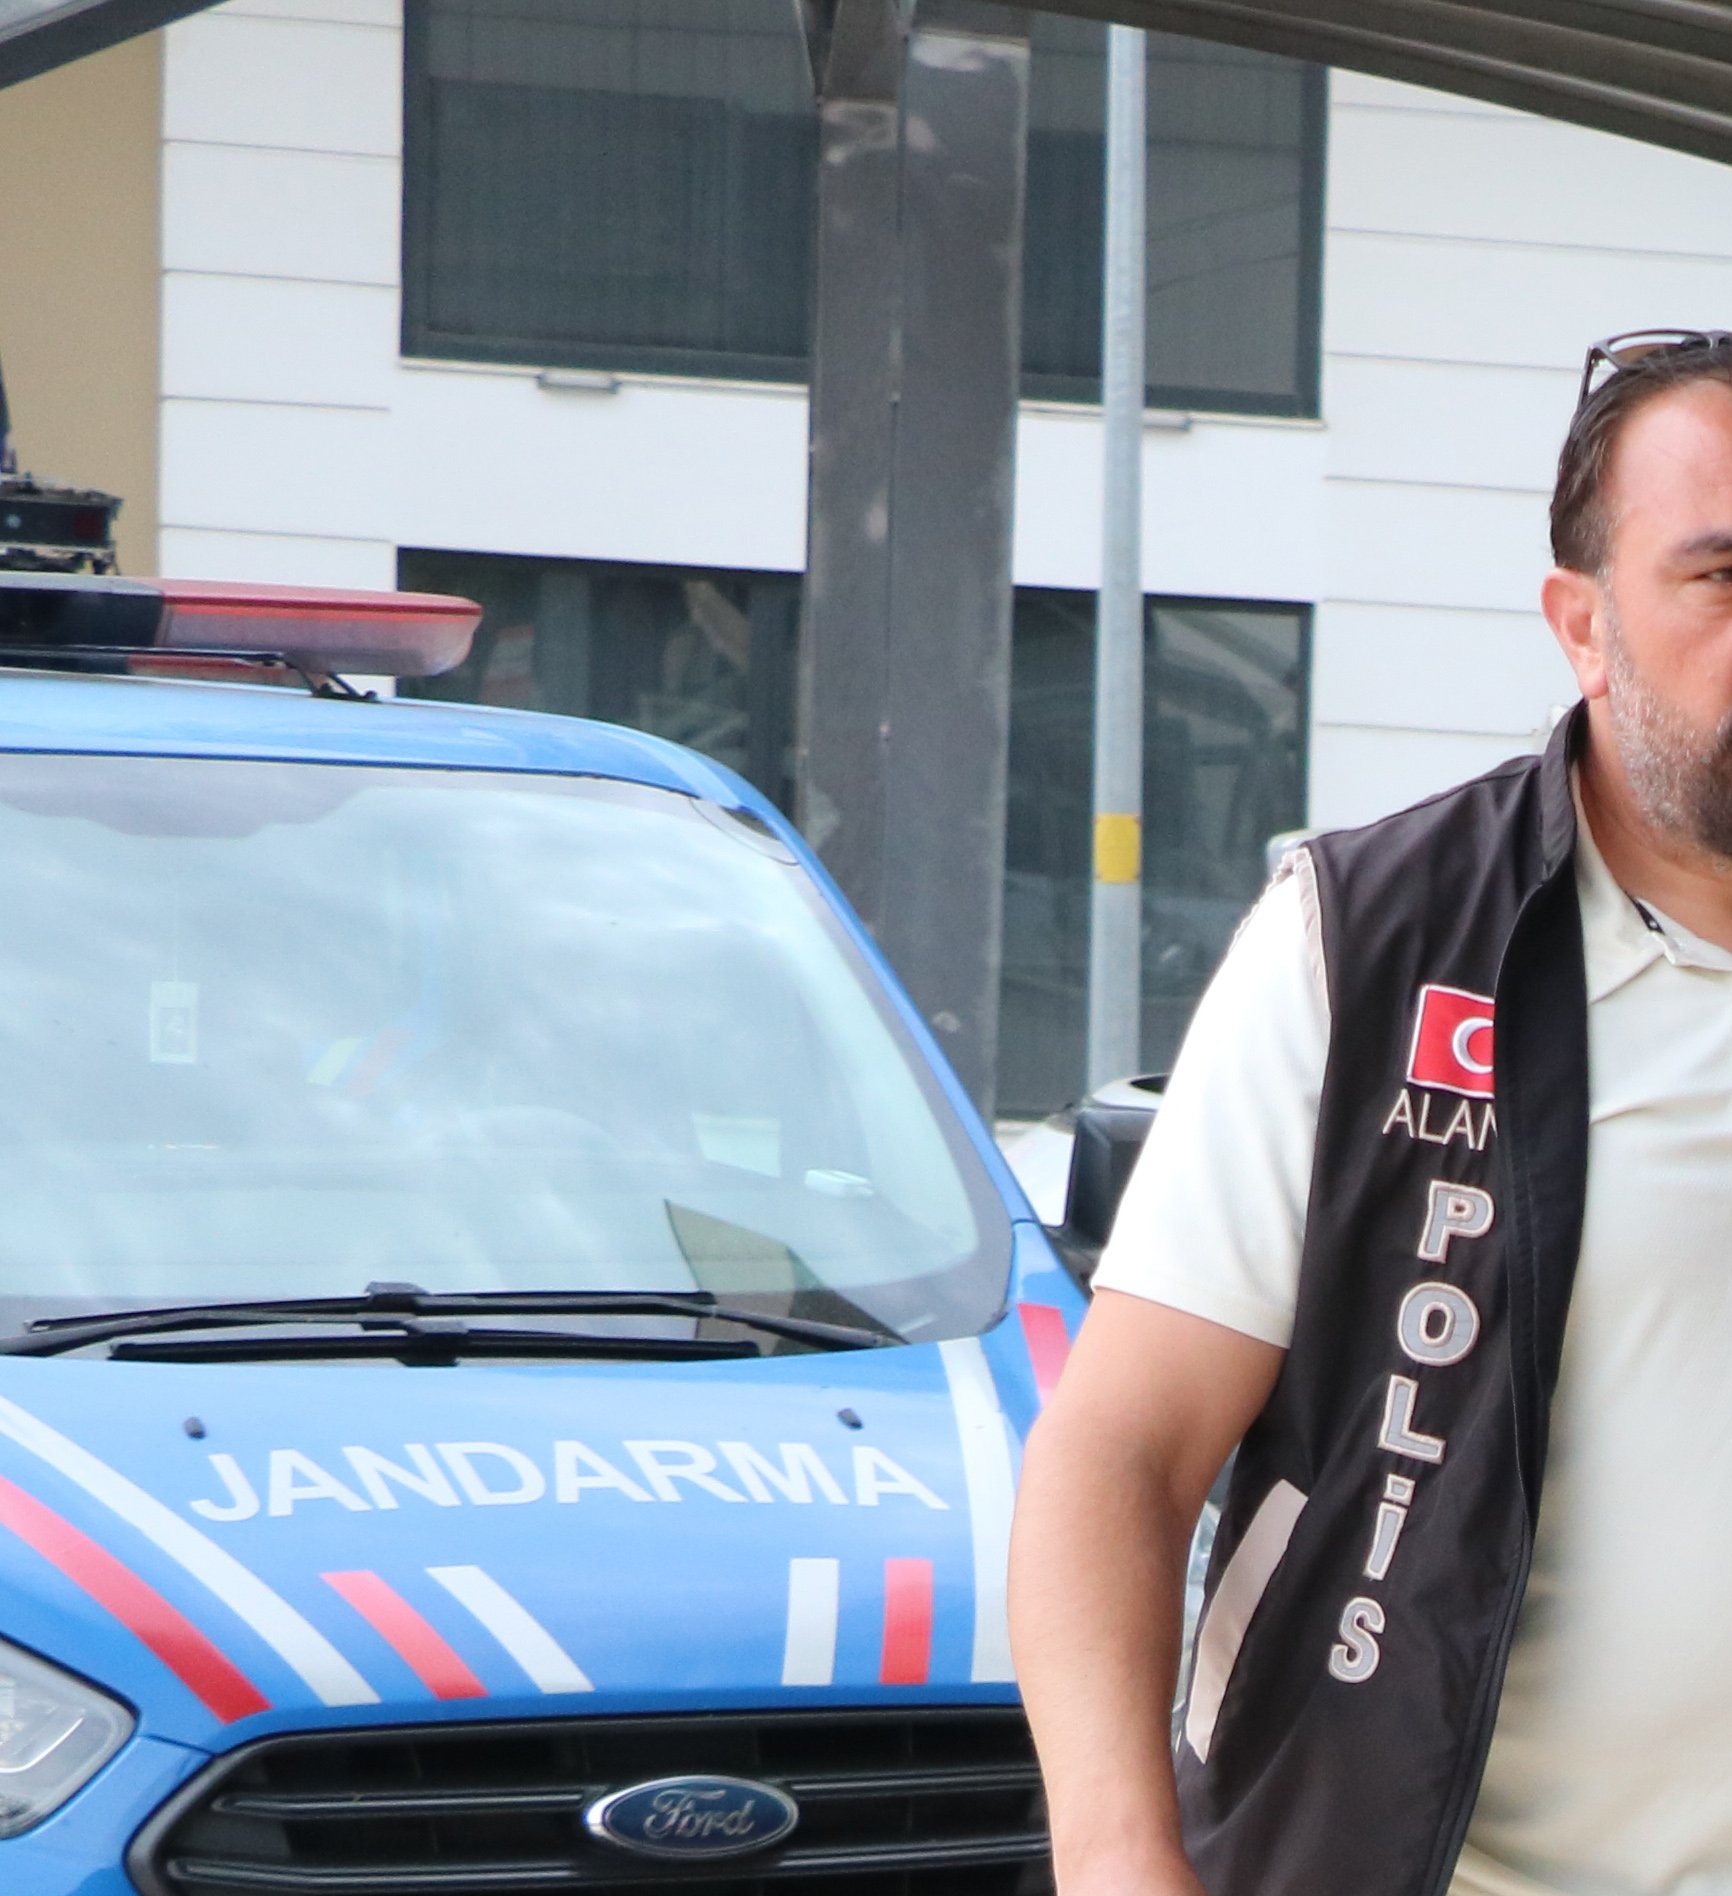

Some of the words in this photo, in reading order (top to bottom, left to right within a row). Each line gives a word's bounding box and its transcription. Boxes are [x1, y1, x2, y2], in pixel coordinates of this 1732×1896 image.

[1382, 1088, 1498, 1151] ALAN
[1328, 1179, 1495, 1684] POLİS
[189, 1439, 951, 1523] JANDARMA
[642, 1788, 756, 1839] Ford
